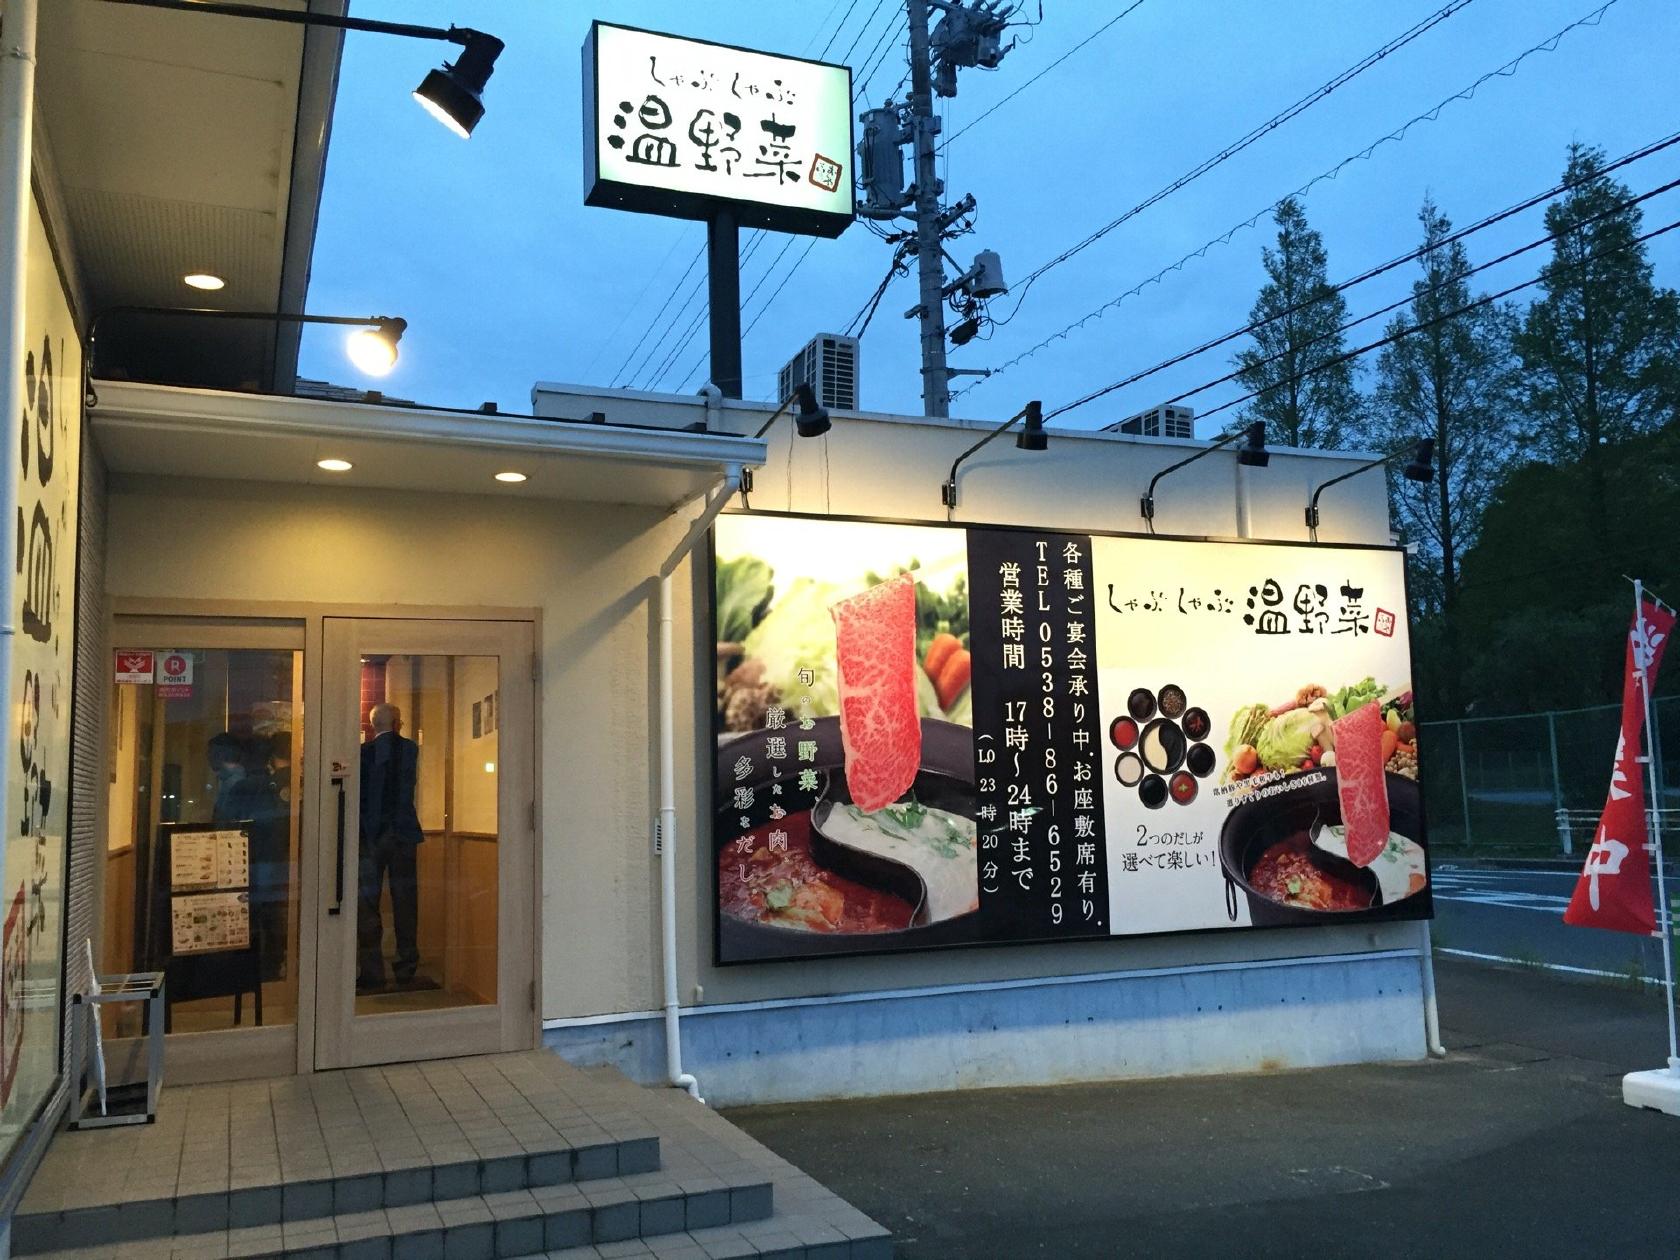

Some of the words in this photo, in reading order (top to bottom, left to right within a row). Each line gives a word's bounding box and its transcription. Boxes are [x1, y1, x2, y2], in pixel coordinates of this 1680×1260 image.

[650, 56, 796, 105] しゃぶしゃぶ
[607, 94, 802, 185] 温野菜
[1108, 583, 1234, 615] しゃぶしゃぶ
[1243, 578, 1369, 637] 温野菜
[734, 755, 755, 883] 多彩なだし
[1136, 824, 1203, 847] 2つのだしが
[1122, 850, 1215, 872] 選べて楽しい！
